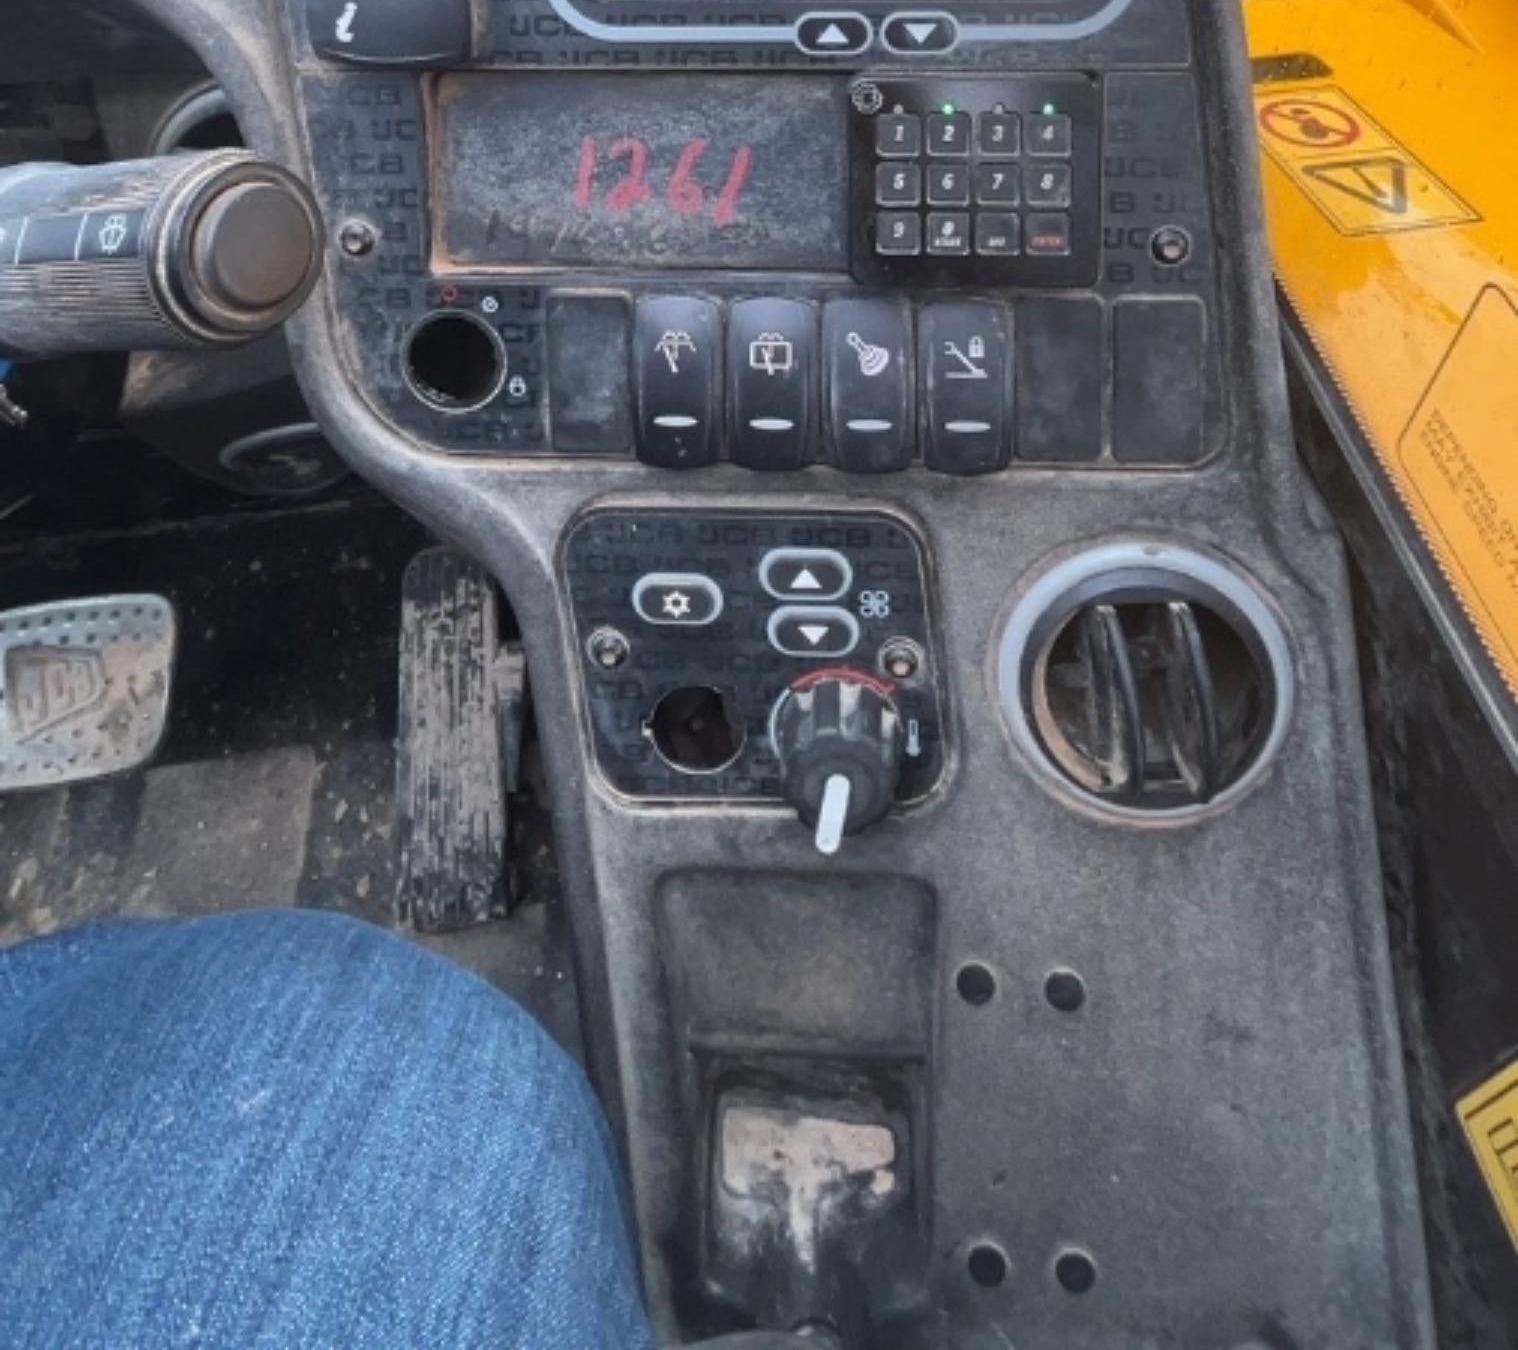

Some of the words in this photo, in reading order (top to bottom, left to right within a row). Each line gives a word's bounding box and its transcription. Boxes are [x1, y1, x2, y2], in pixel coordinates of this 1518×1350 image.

[894, 125, 905, 143] 1
[942, 125, 956, 142] 2
[992, 125, 1004, 142] 3
[1041, 125, 1054, 141] 4
[572, 136, 754, 230] 1261
[893, 173, 906, 190] 5
[941, 173, 955, 190] 6
[992, 173, 1004, 190] 7
[1040, 173, 1054, 190] 8
[893, 221, 905, 238] 9
